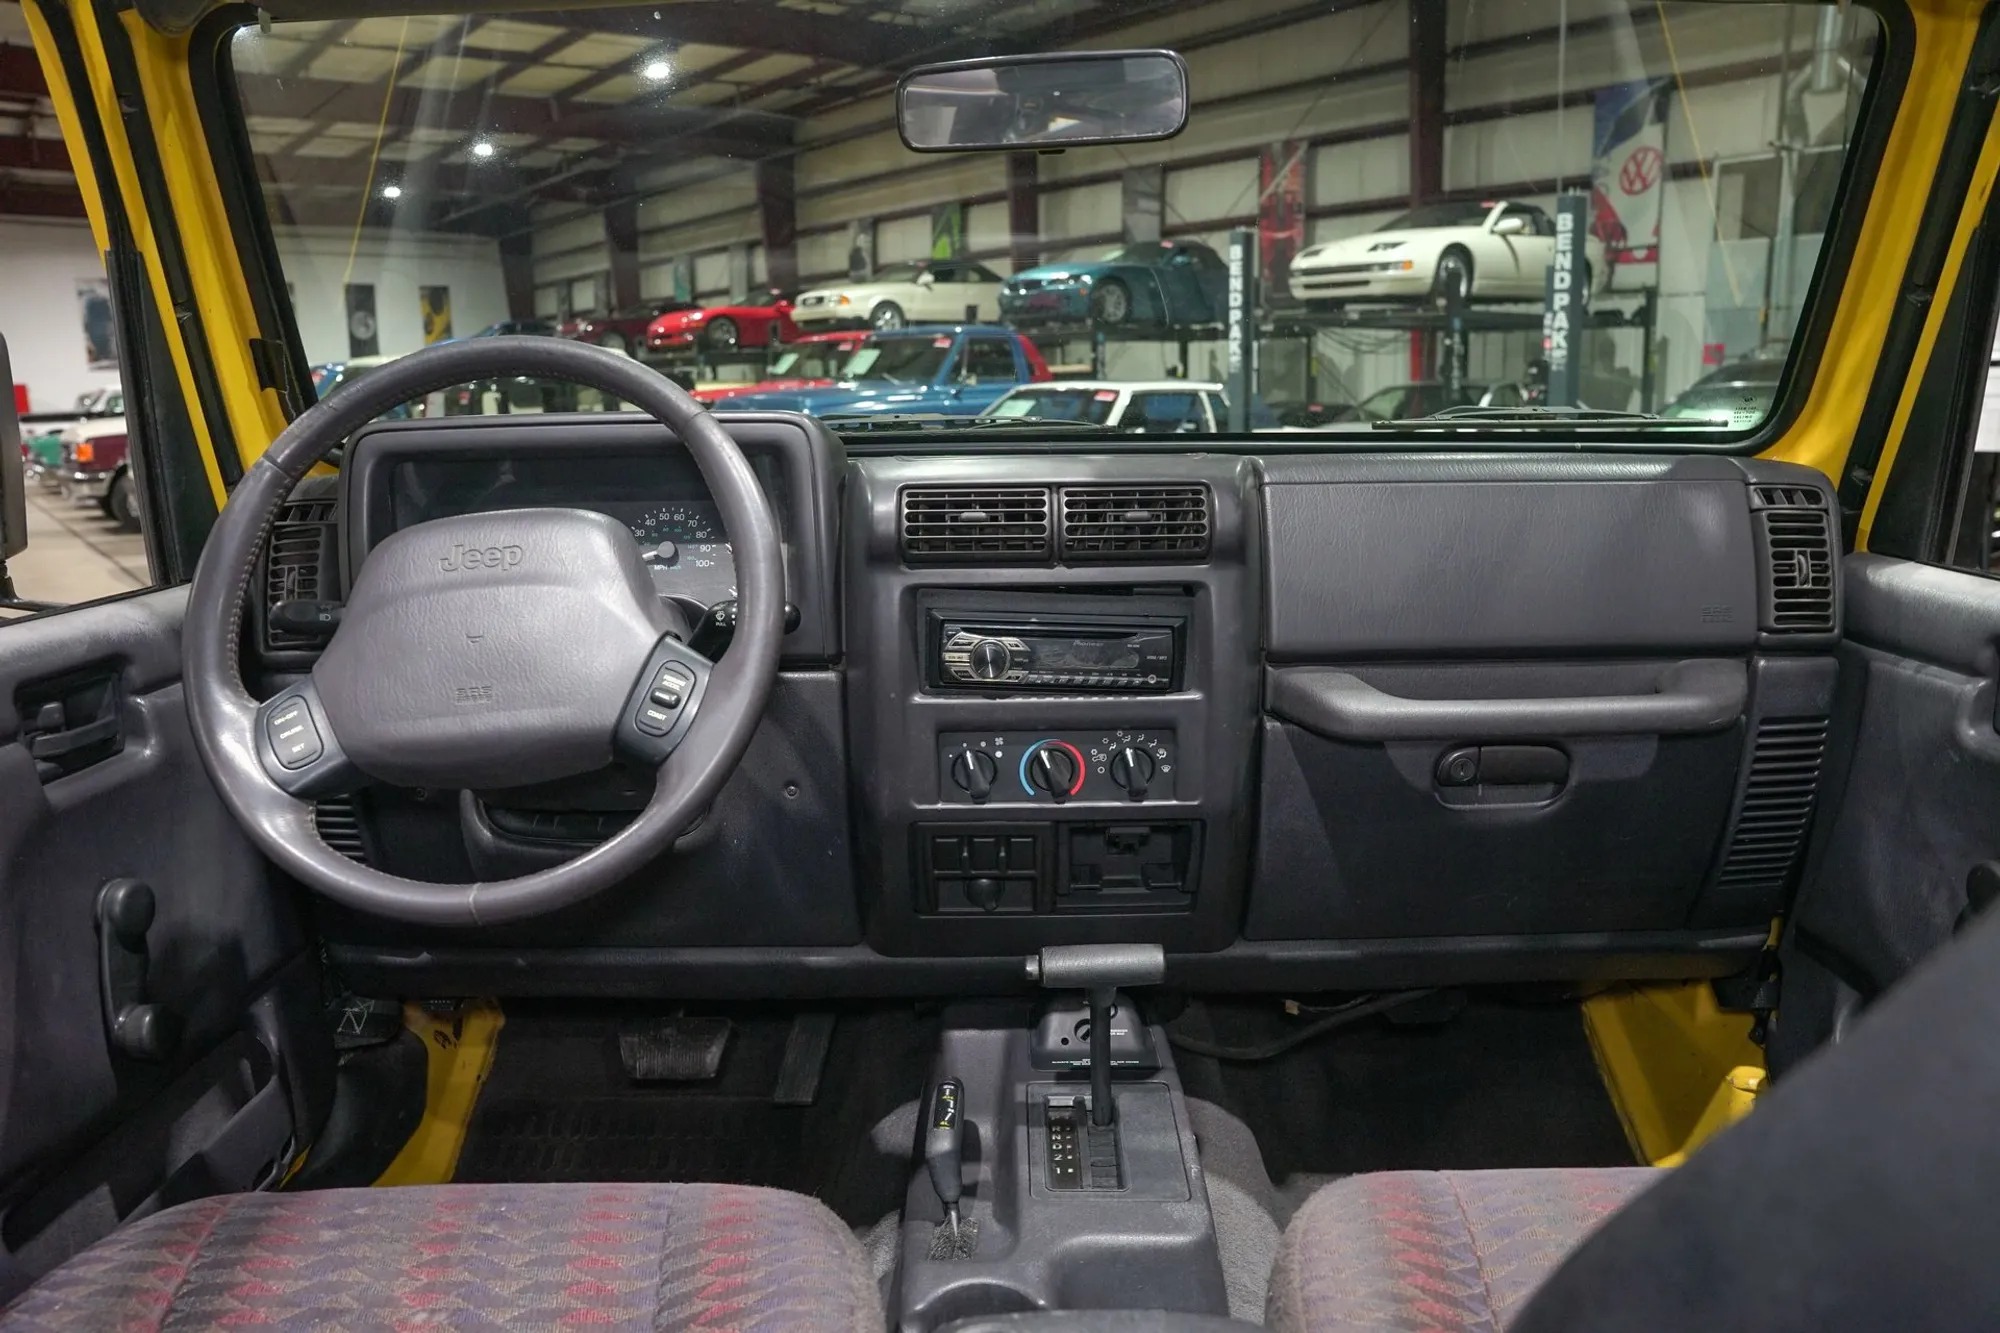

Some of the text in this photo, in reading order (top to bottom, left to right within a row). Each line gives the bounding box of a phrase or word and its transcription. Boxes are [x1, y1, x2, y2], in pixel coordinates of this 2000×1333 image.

[1553, 212, 1574, 349] BENDPAK
[634, 529, 645, 537] 30
[699, 544, 711, 552] 90
[439, 545, 523, 572] Jeep
[647, 709, 667, 721] COAST
